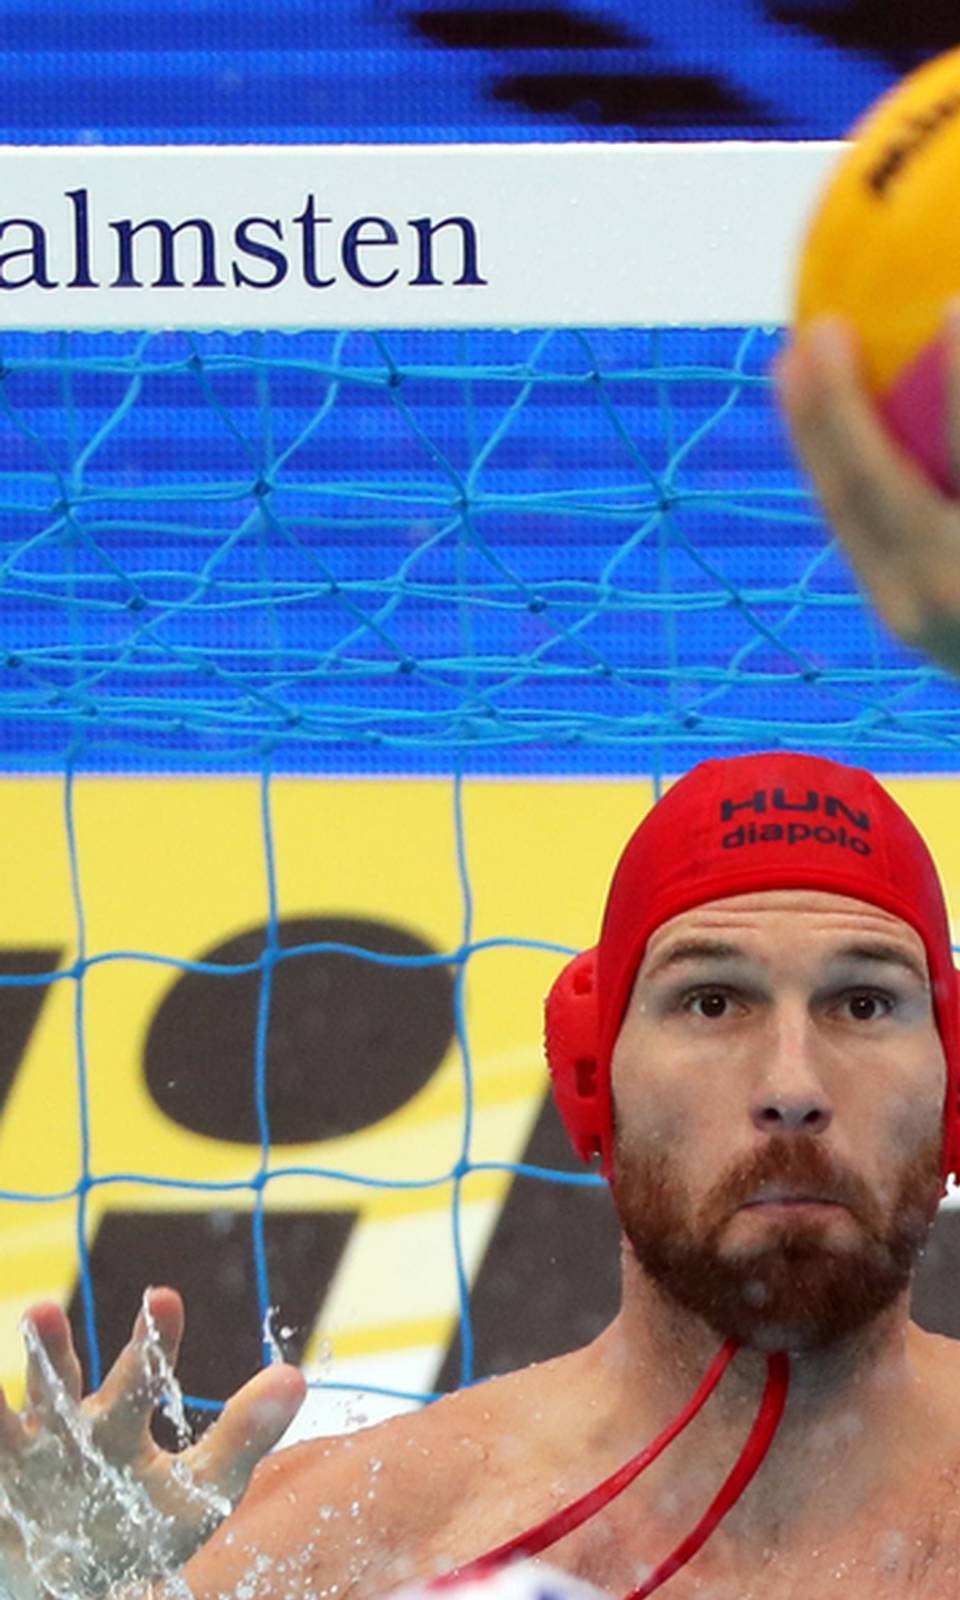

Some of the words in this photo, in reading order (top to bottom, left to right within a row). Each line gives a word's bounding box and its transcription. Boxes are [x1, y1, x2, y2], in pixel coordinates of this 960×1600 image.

[0, 188, 489, 291] almsten
[720, 788, 871, 832] HUN
[721, 821, 873, 856] diapolo
